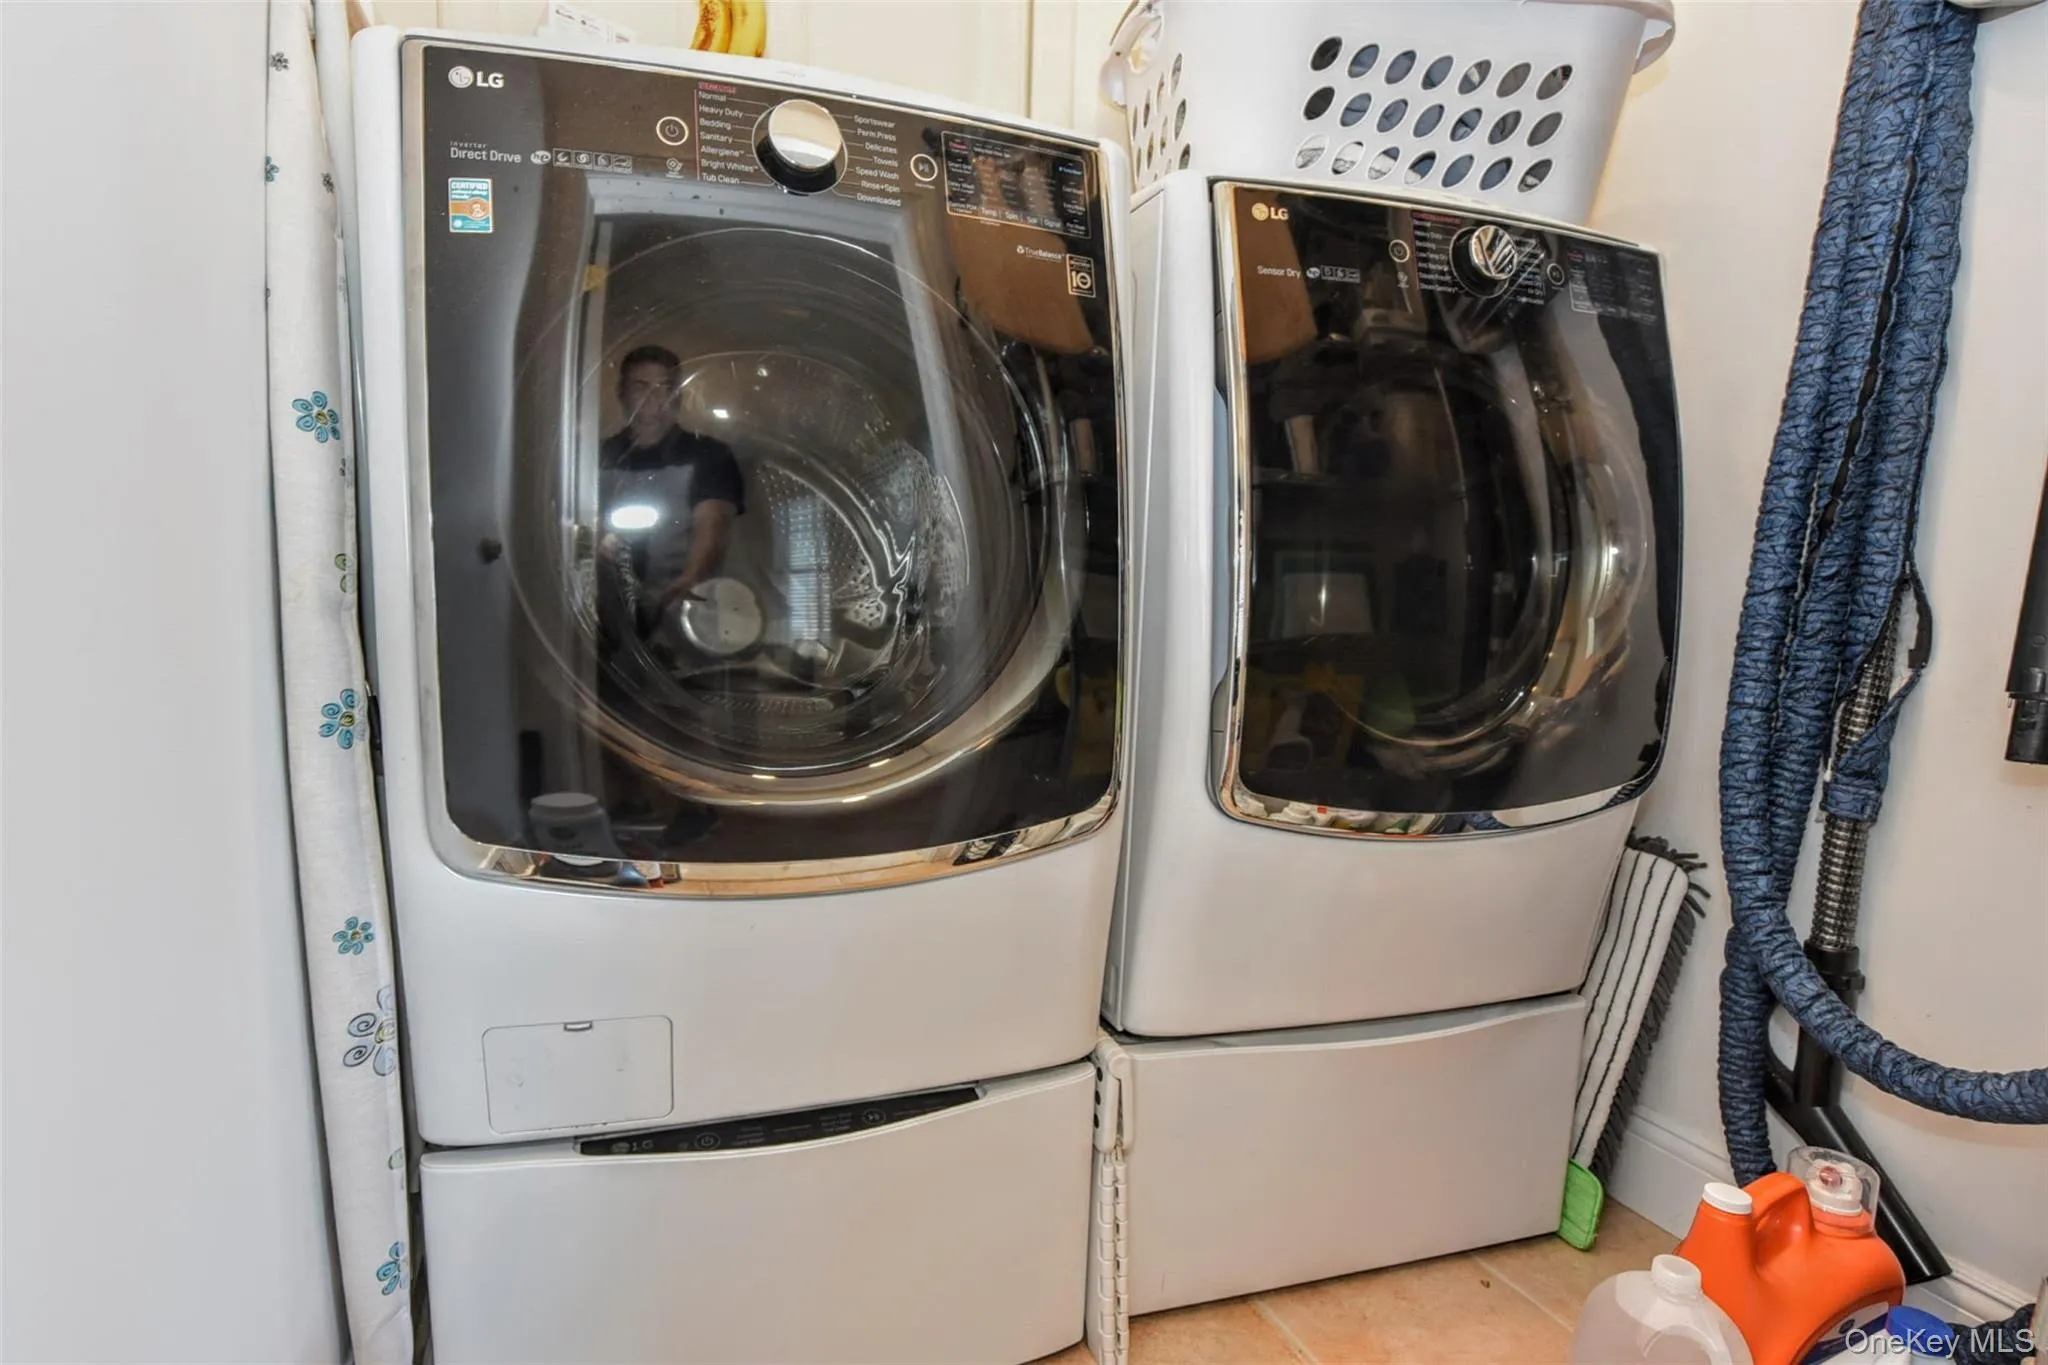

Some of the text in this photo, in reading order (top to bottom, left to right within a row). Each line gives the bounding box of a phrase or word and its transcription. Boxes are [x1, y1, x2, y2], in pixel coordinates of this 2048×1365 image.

[476, 71, 505, 88] LG
[699, 91, 727, 102] Normal
[699, 104, 743, 119] Heavy Duty
[700, 118, 731, 130] Bedding
[854, 114, 896, 129] Sportswear
[700, 131, 733, 144] Sanitary
[450, 146, 522, 163] Direct Drive
[865, 141, 898, 154] Delicates
[701, 158, 725, 170] Bright
[873, 155, 899, 168] Towels
[702, 172, 740, 185] Tub Clean
[855, 166, 900, 181] Speed Wash
[857, 192, 902, 207] Downloaded
[1270, 206, 1289, 221] LG
[1256, 264, 1301, 280] Sensor Dry
